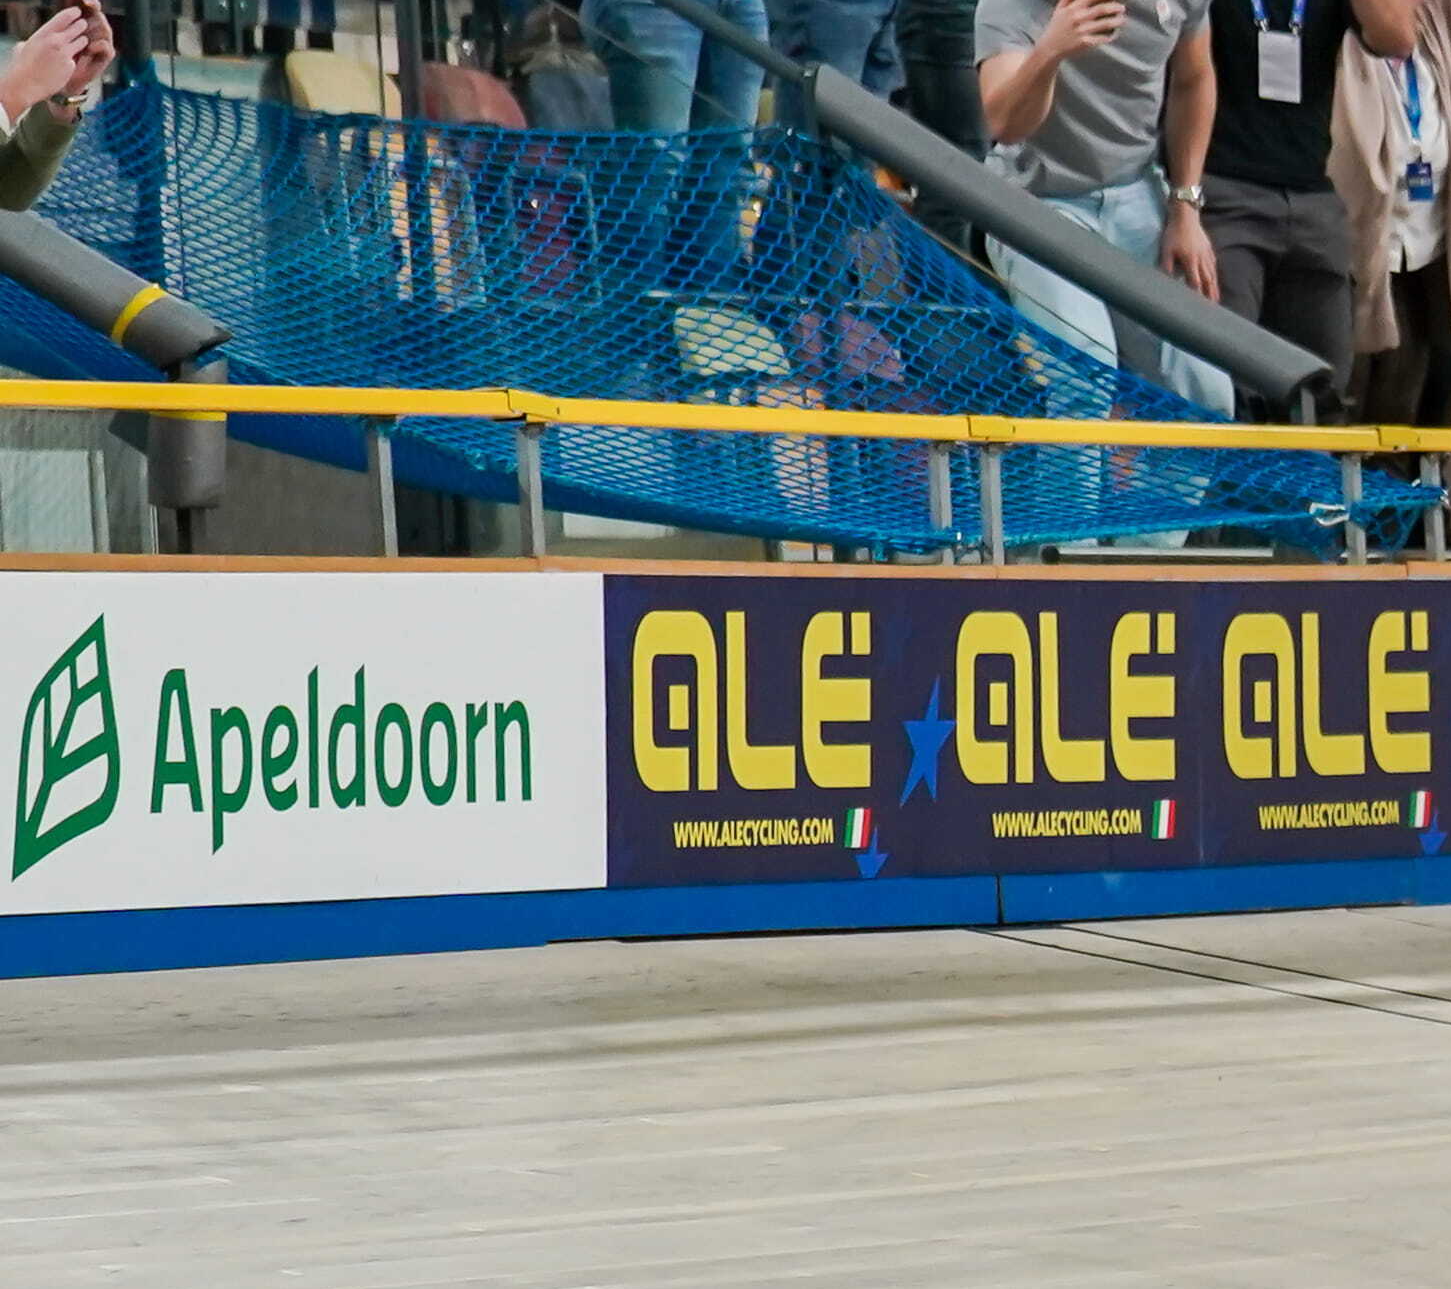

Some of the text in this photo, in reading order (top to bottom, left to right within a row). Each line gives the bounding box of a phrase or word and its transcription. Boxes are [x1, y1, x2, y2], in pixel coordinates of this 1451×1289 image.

[150, 665, 533, 855] Apeldoorn
[992, 809, 1142, 838] WWW.ALECYCLING.COM
[1258, 800, 1400, 830] WWW.ALECYCLING.COM
[674, 817, 835, 848] WWW.ALECYCLING.COM
